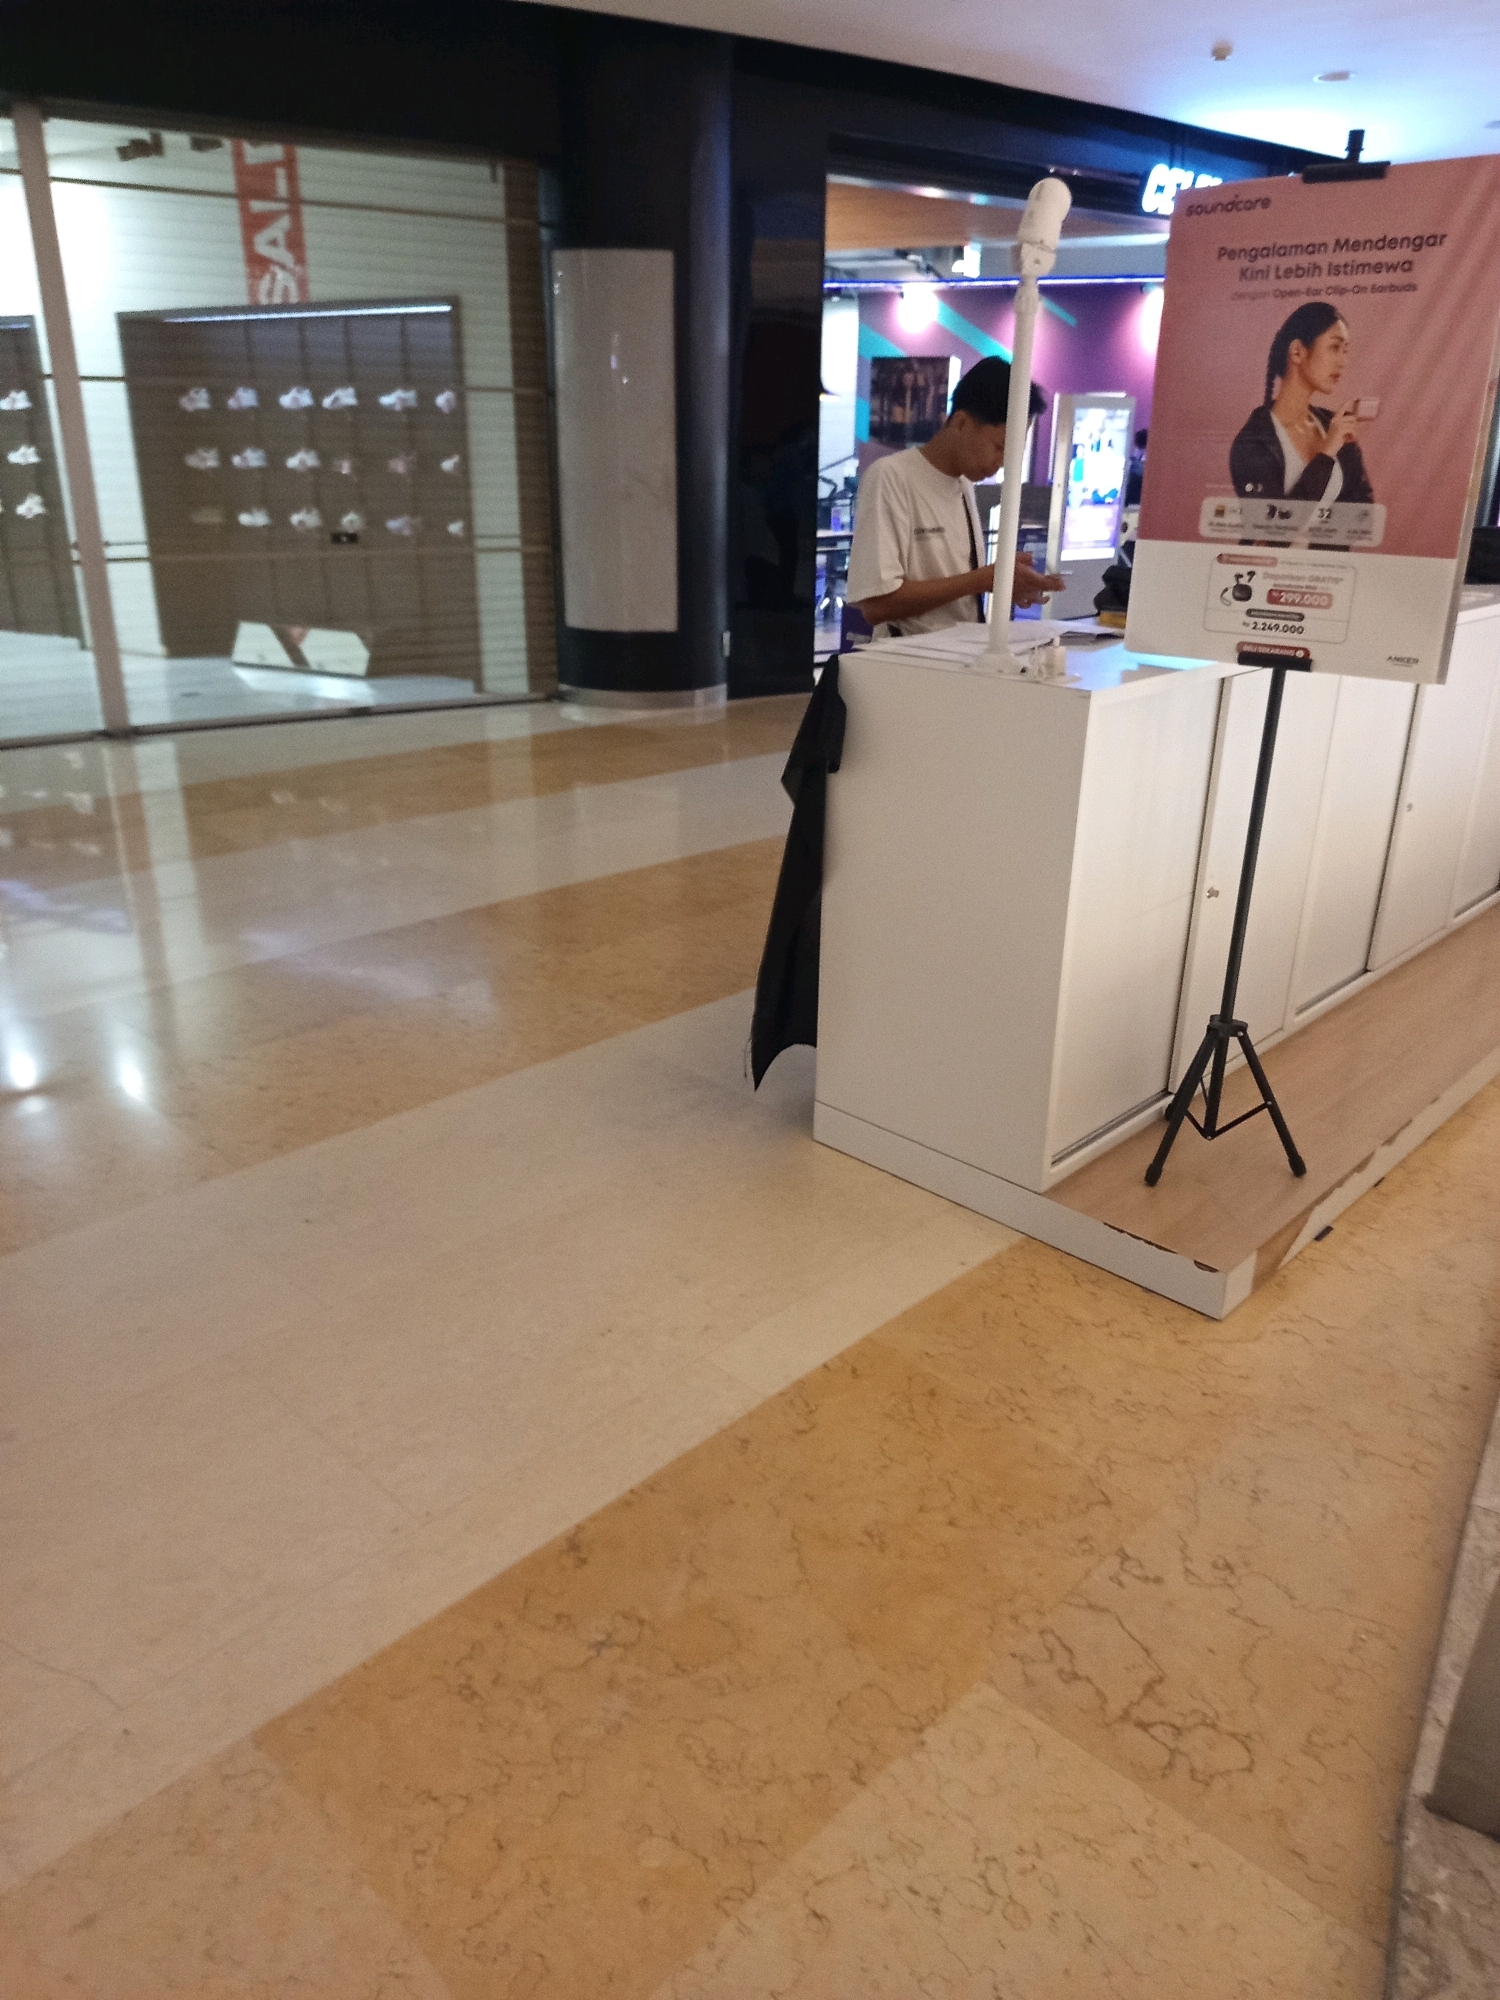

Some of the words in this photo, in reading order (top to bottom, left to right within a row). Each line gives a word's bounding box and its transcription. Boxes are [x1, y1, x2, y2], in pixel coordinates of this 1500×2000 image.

[1185, 194, 1272, 218] soundcore
[1217, 241, 1328, 263] Pengalaman
[1332, 233, 1448, 252] Mendengar
[1239, 263, 1271, 282] Kini
[1274, 261, 1323, 280] Lebih
[1327, 259, 1414, 278] Istimewa
[1272, 286, 1323, 300] Open-Ear
[1326, 284, 1368, 297] Clip-On
[1370, 282, 1418, 294] Earbuds
[1279, 592, 1330, 607] 299.000
[1252, 621, 1305, 635] 2.249.000
